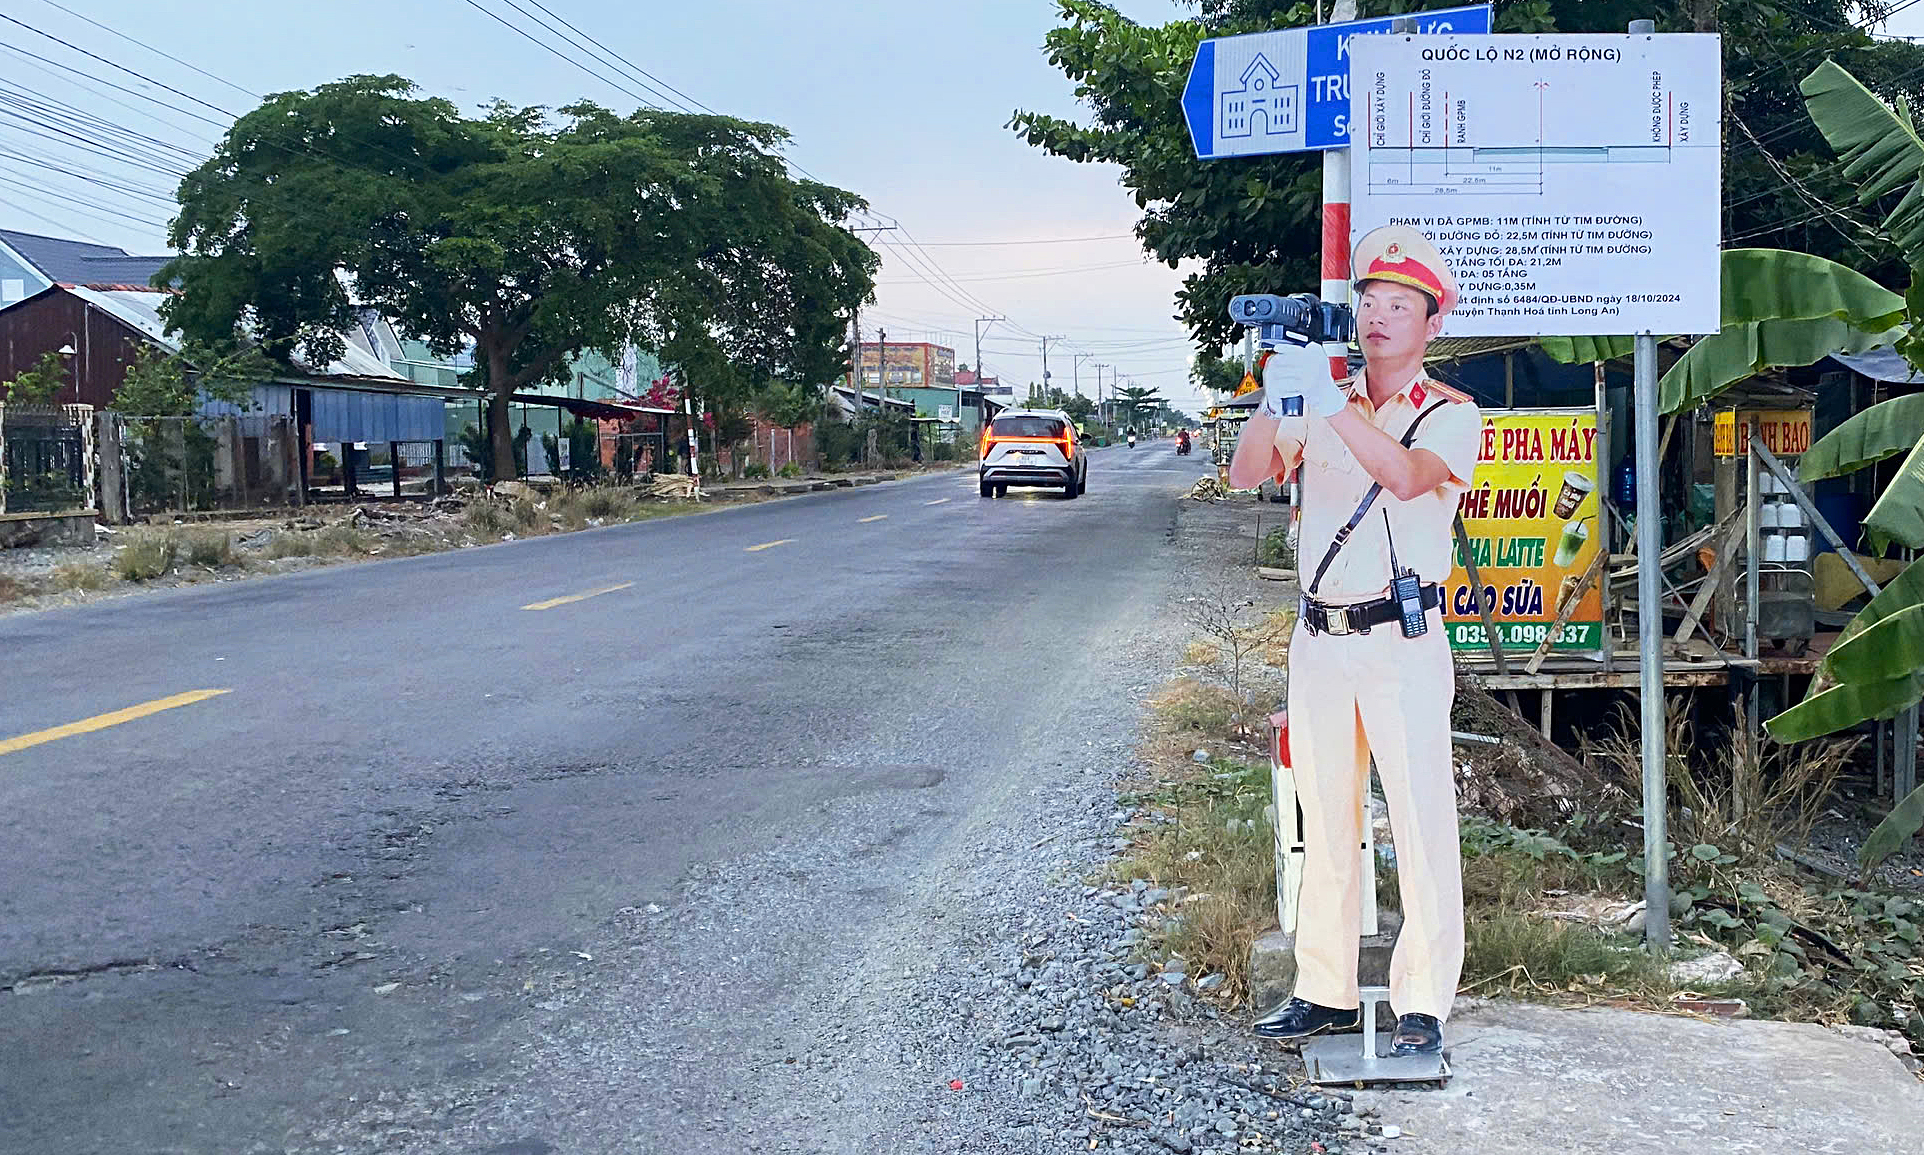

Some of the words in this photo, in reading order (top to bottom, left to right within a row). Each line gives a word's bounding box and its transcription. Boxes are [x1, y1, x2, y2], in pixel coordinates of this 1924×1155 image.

[1421, 44, 1470, 61] QUỐC
[1476, 46, 1498, 63] LỘ
[1503, 49, 1525, 61] N2
[1529, 45, 1561, 63] (MỞ
[1567, 46, 1621, 63] RỘNG)
[1678, 101, 1690, 124] DỰNG
[1651, 115, 1661, 142] KHÔNG
[1678, 127, 1689, 142] XÂY
[1423, 217, 1435, 226] VI
[1436, 216, 1453, 226] ĐÃ
[1456, 217, 1494, 226] GPMB:
[1496, 217, 1519, 226] 11M
[1521, 215, 1551, 227] (TÍNH
[1555, 215, 1571, 225] TỪ
[1574, 217, 1593, 225] TIM
[1595, 215, 1643, 227] ĐƯỜNG)
[1440, 230, 1481, 241] ĐƯỜNG
[1484, 229, 1504, 240] ĐỎ:
[1506, 231, 1538, 241] 22,5M
[1541, 230, 1568, 240] (TÍNH
[1571, 230, 1585, 239] TỪ
[1587, 231, 1605, 239] TIM
[1607, 229, 1653, 241] ĐƯỜNG)
[1439, 245, 1463, 255] XÂY
[1466, 246, 1503, 256] DỰNG:
[1540, 244, 1567, 255] (TÍNH
[1570, 244, 1584, 254] TỪ
[1586, 246, 1604, 254] TIM
[1606, 244, 1652, 255] ĐƯỜNG)
[1488, 255, 1505, 266] TỐI
[1530, 258, 1562, 267] 21,2M
[1482, 270, 1495, 278] 05
[1470, 295, 1494, 306] định
[1497, 294, 1511, 304] số
[1513, 294, 1593, 304] 6484/QĐ-UBND
[1596, 295, 1622, 305] ngày
[1625, 294, 1681, 304] 18/10/2024
[1488, 307, 1521, 317] Thạnh
[1524, 306, 1545, 316] Hoá
[1571, 307, 1598, 317] Long
[1600, 306, 1620, 317] An)
[1502, 428, 1544, 461] PHA
[1550, 418, 1598, 461] MÁY
[1782, 421, 1809, 453] BAO
[1493, 474, 1548, 518] MUỐI
[1496, 538, 1546, 567] LATTE
[1501, 578, 1544, 616] SỮA
